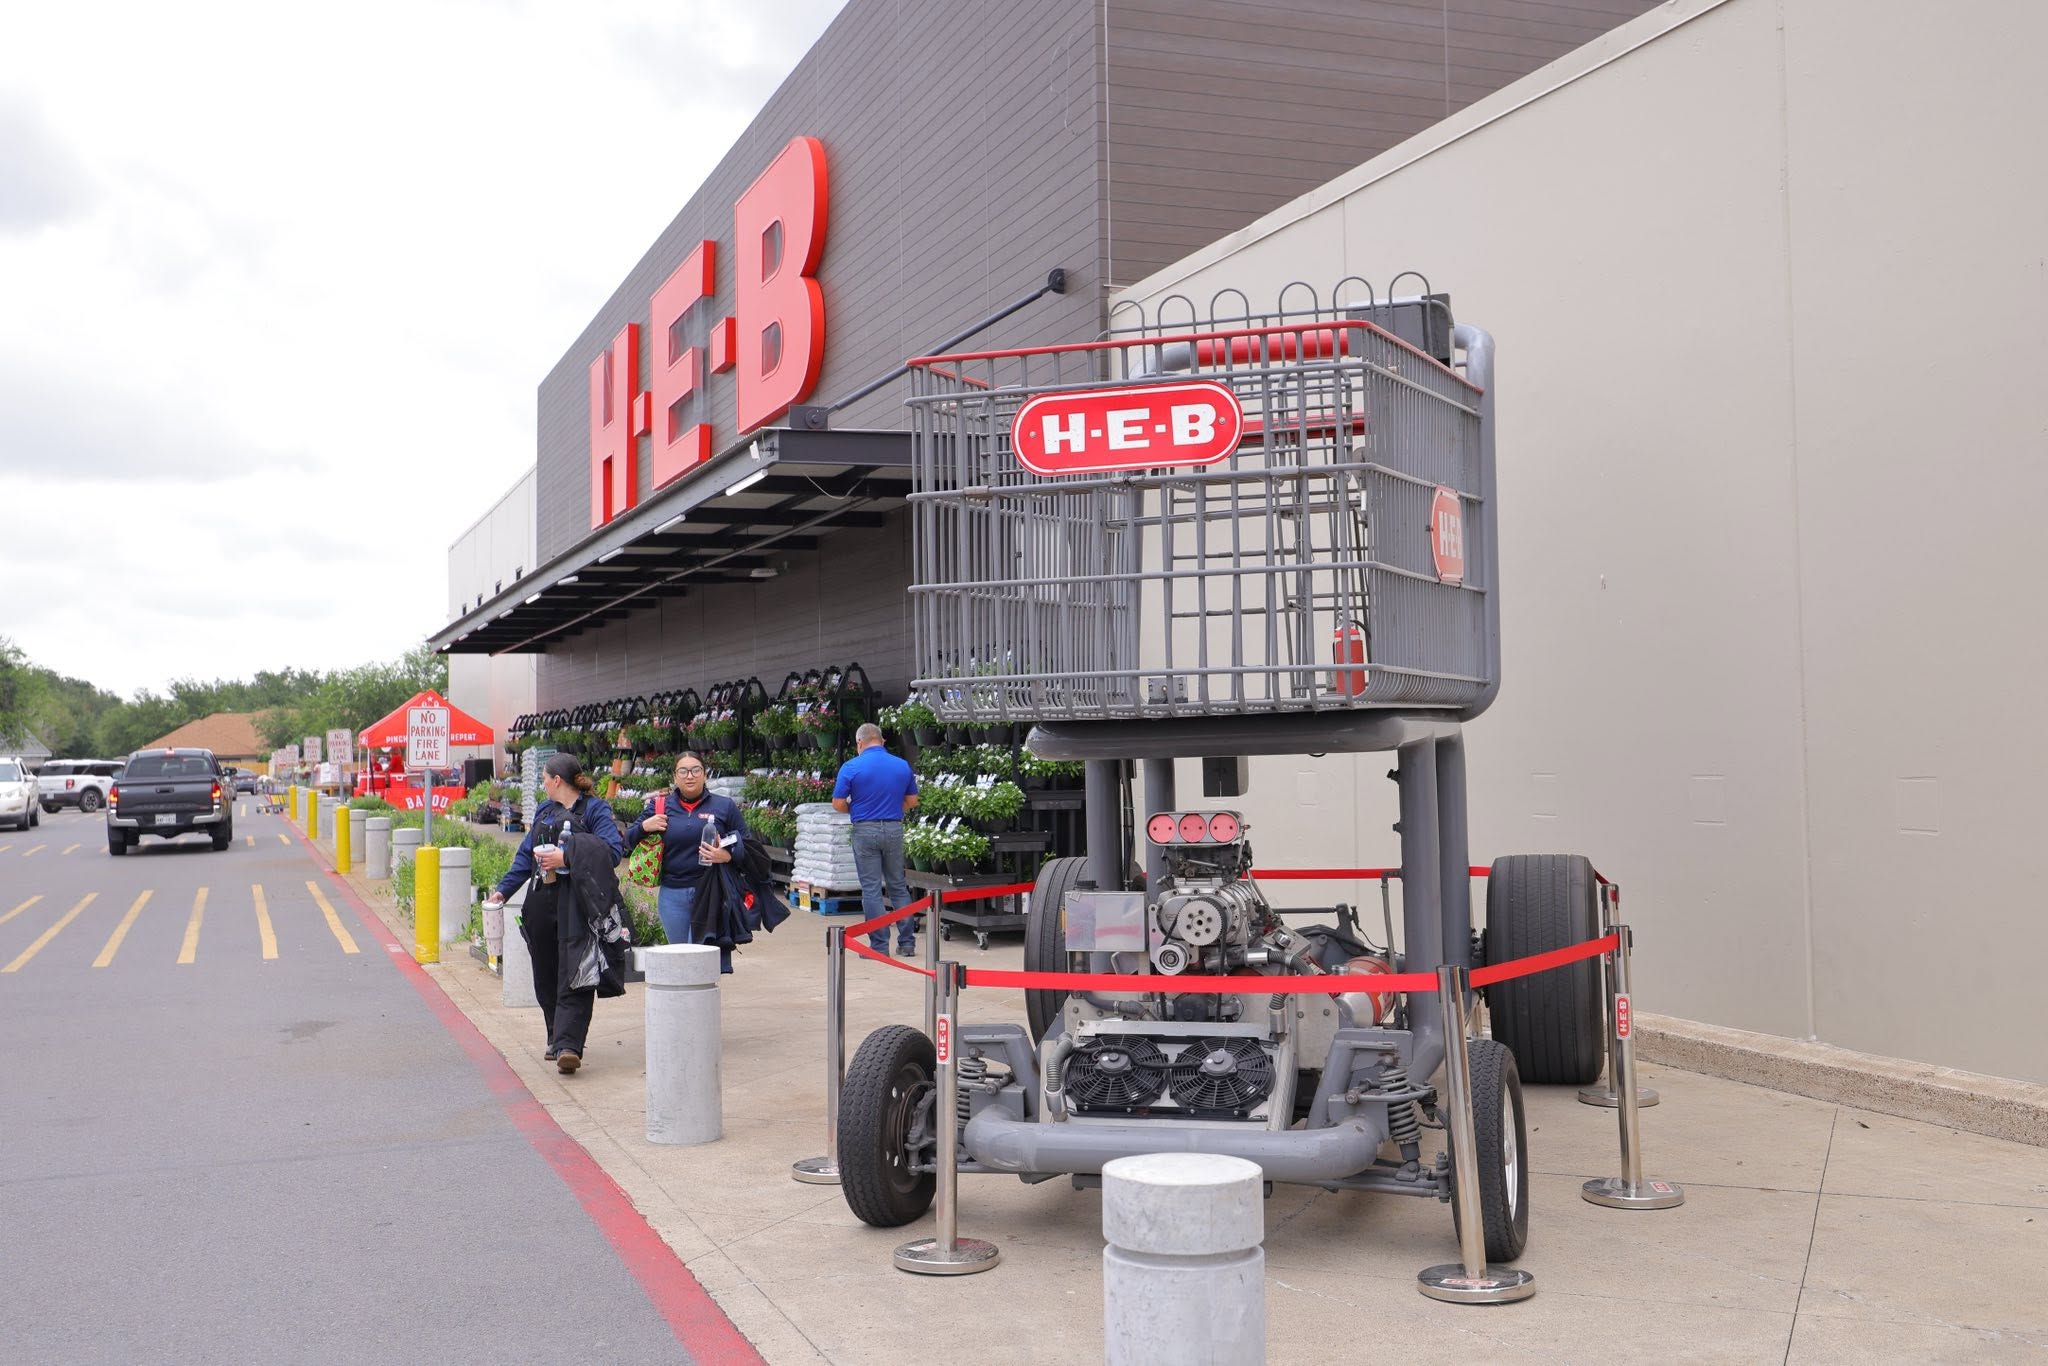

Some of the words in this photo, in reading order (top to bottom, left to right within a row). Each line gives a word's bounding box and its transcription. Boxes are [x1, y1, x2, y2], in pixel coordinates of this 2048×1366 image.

[590, 136, 828, 530] H-E-B
[1042, 403, 1216, 454] H-E-B
[421, 712, 436, 724] NO
[410, 726, 446, 737] PARKING
[416, 739, 439, 749] FIRE
[415, 750, 440, 760] LANE
[405, 795, 448, 809] BAOU
[1619, 1001, 1627, 1032] H-E-B
[939, 1021, 947, 1057] H-E-B
